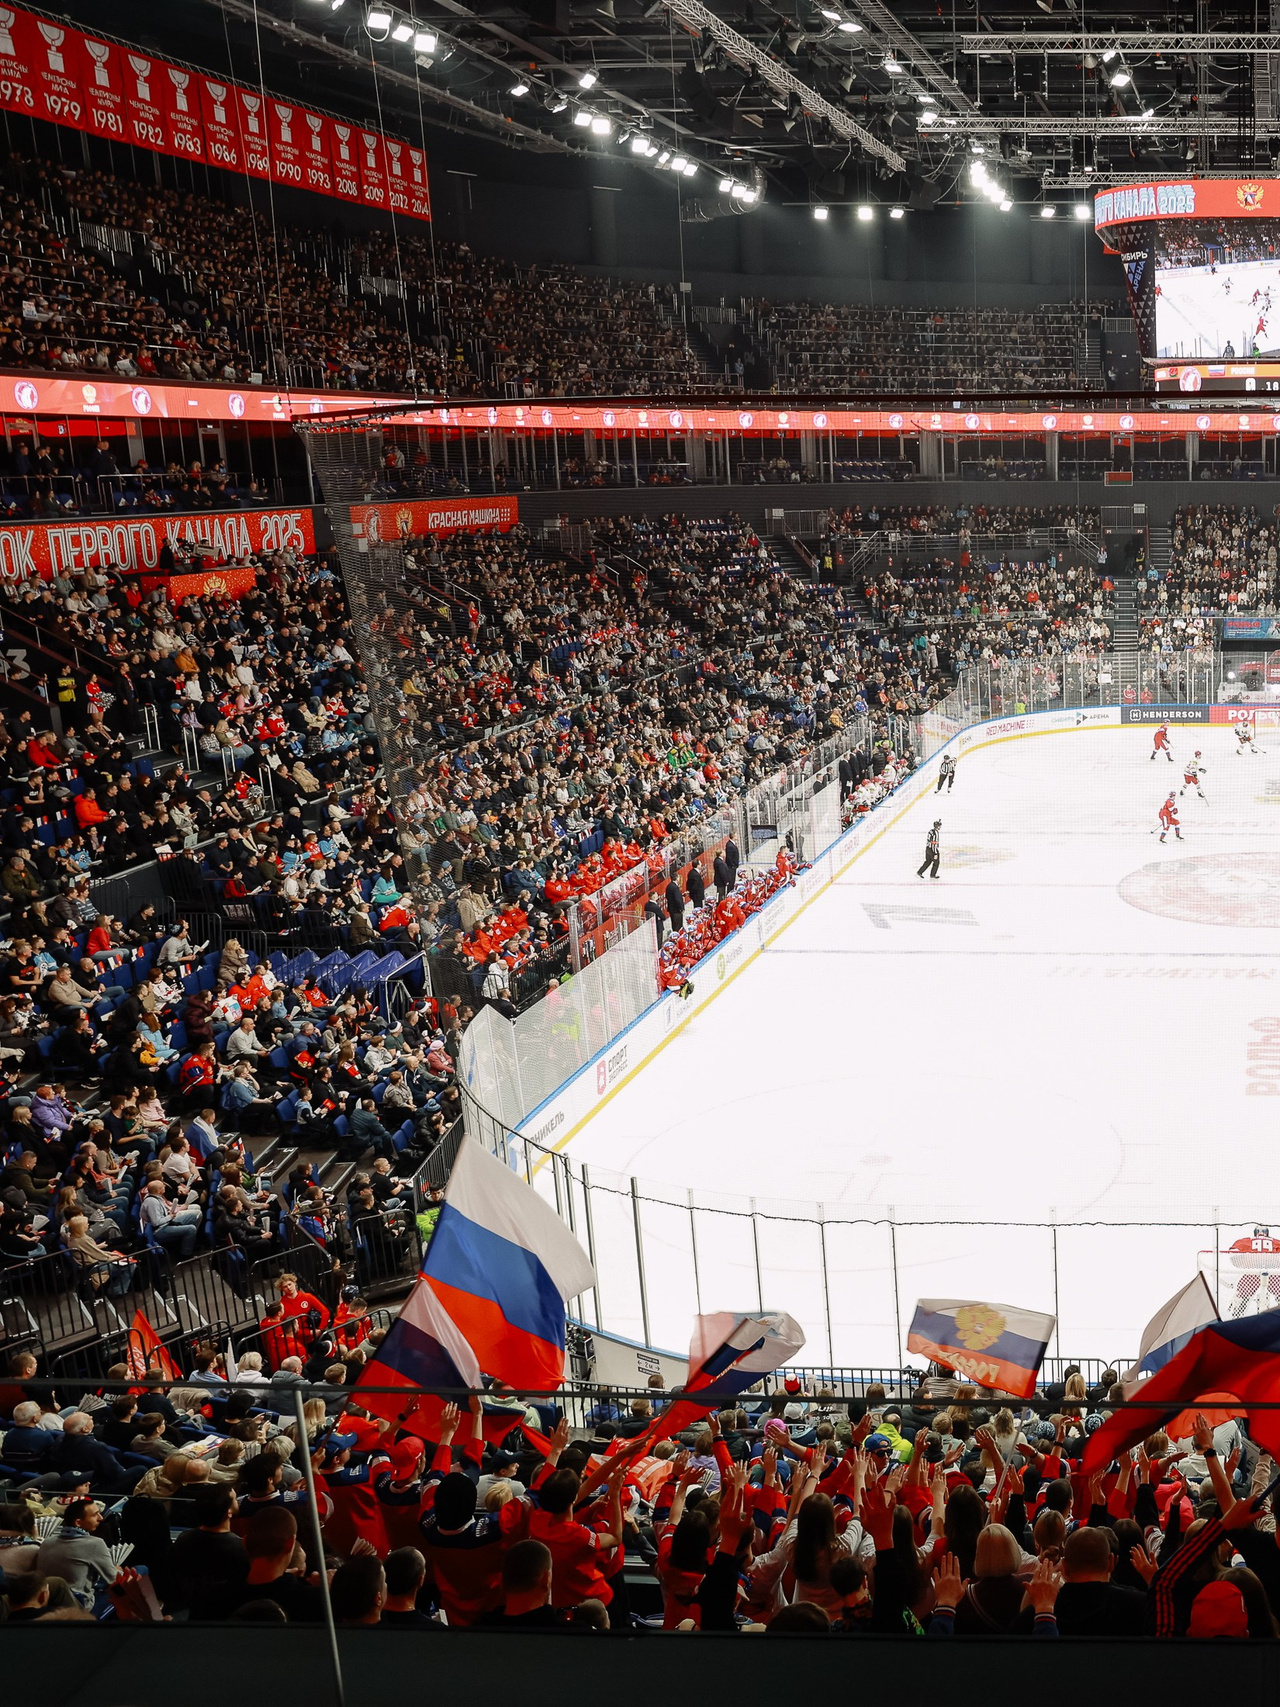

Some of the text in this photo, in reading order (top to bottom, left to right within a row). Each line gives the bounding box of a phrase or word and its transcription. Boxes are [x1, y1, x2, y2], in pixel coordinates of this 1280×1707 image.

[0, 80, 34, 108] 978
[44, 92, 81, 121] 1979
[92, 108, 123, 133] 1981
[133, 120, 164, 146] 1982
[173, 130, 201, 155] 1983
[210, 142, 237, 165] 1986
[246, 152, 269, 172] 1989
[275, 160, 301, 181] 1990
[307, 168, 331, 189] 1993
[336, 177, 358, 196] 2008
[363, 184, 384, 203] 2009
[389, 192, 409, 210] 2012
[1115, 192, 1156, 219] КАНАЛА
[1158, 190, 1195, 214] 2025
[428, 508, 500, 529] КРАСНАЯ МАШИНА
[47, 523, 157, 578] ПЕРВОГО
[261, 513, 305, 556] 2025
[1142, 710, 1202, 719] HENDERSON
[997, 720, 1026, 734] MACHINE
[607, 1043, 629, 1073] СПОРТ
